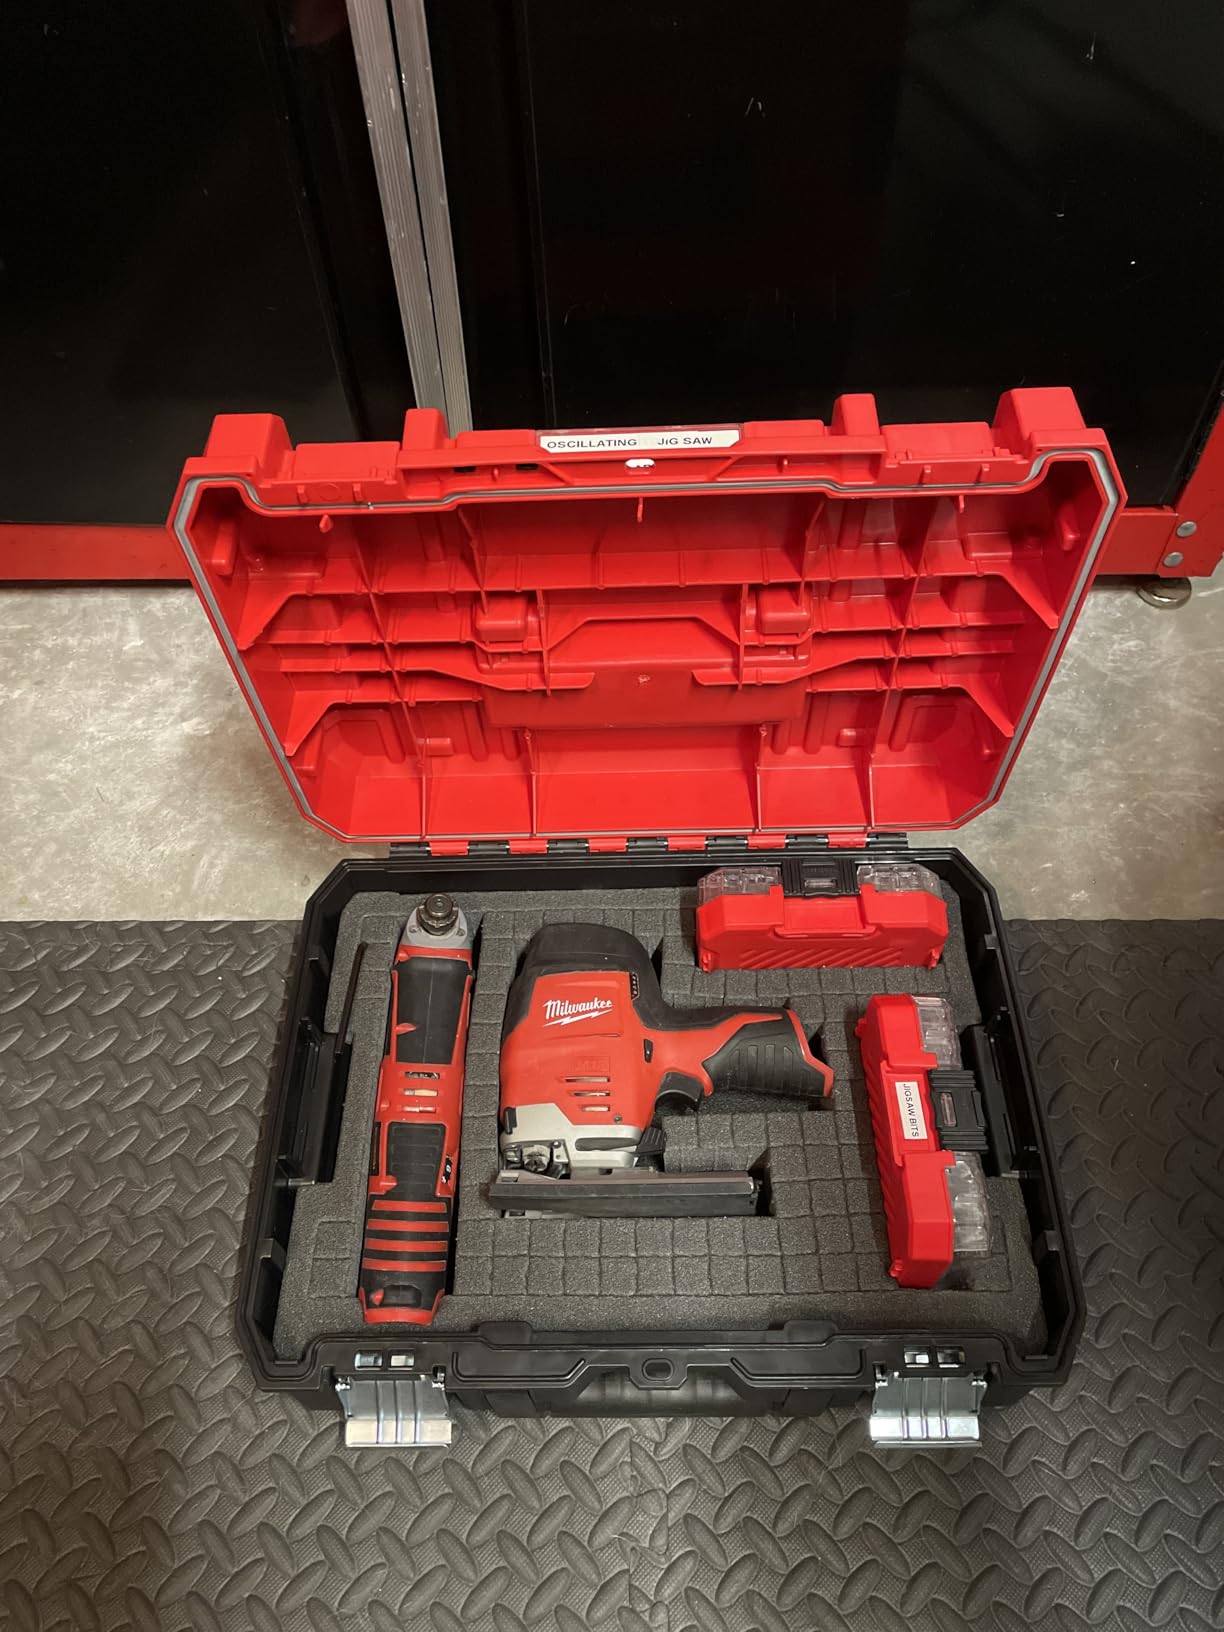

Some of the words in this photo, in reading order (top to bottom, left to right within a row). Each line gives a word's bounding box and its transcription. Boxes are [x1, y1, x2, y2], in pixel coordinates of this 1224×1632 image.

[547, 438, 638, 449] OSCILLATING
[682, 437, 712, 445] SAW
[542, 997, 613, 1020] Milwaukee
[903, 1083, 916, 1117] JIGSAW
[909, 1118, 920, 1137] BITS
